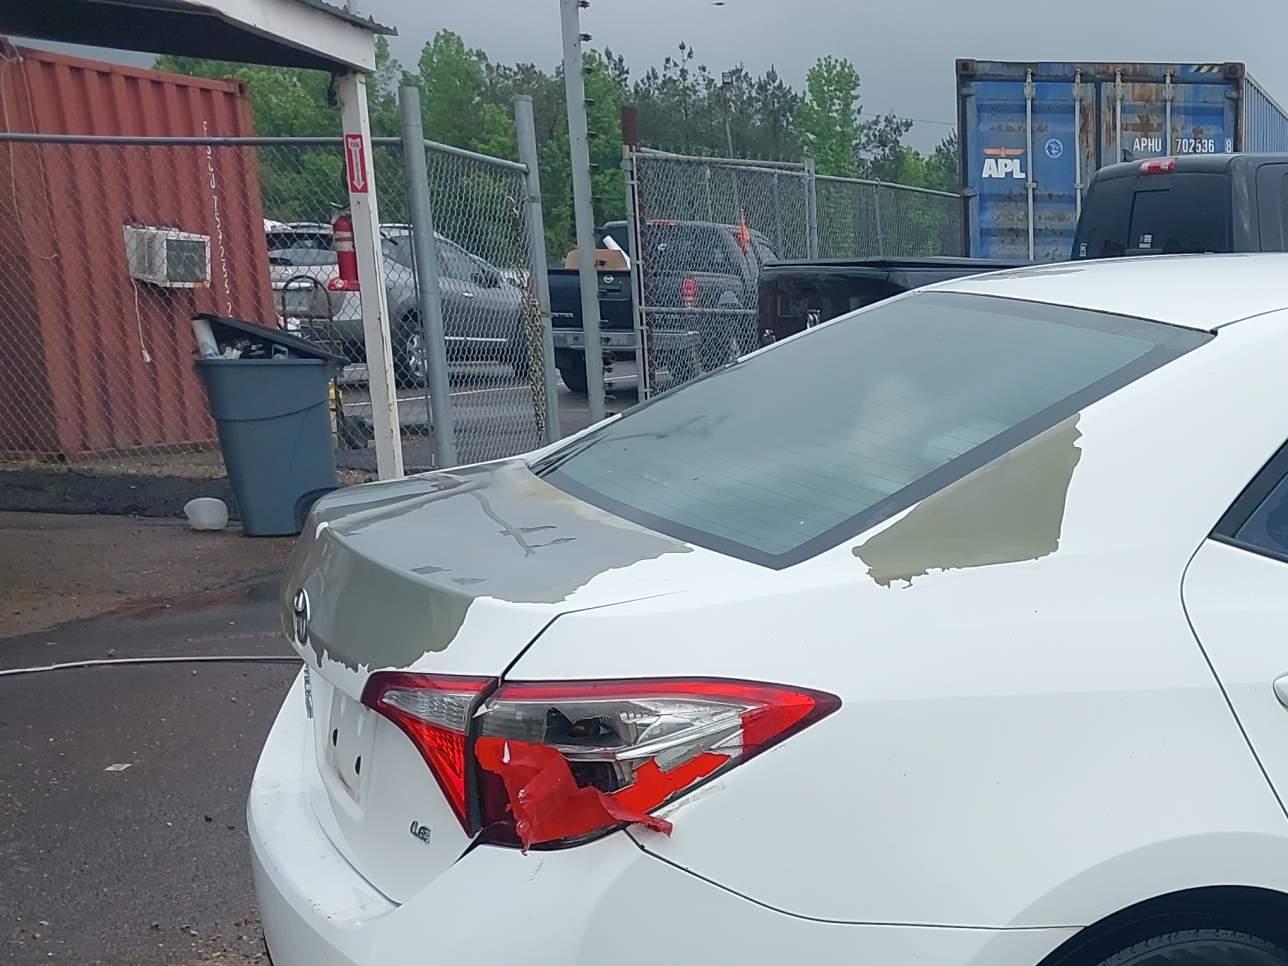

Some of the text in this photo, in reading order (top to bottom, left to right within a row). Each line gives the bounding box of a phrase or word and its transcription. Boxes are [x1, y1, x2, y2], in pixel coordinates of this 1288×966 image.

[1132, 138, 1233, 154] APHU 702536 8
[982, 157, 1026, 178] APL
